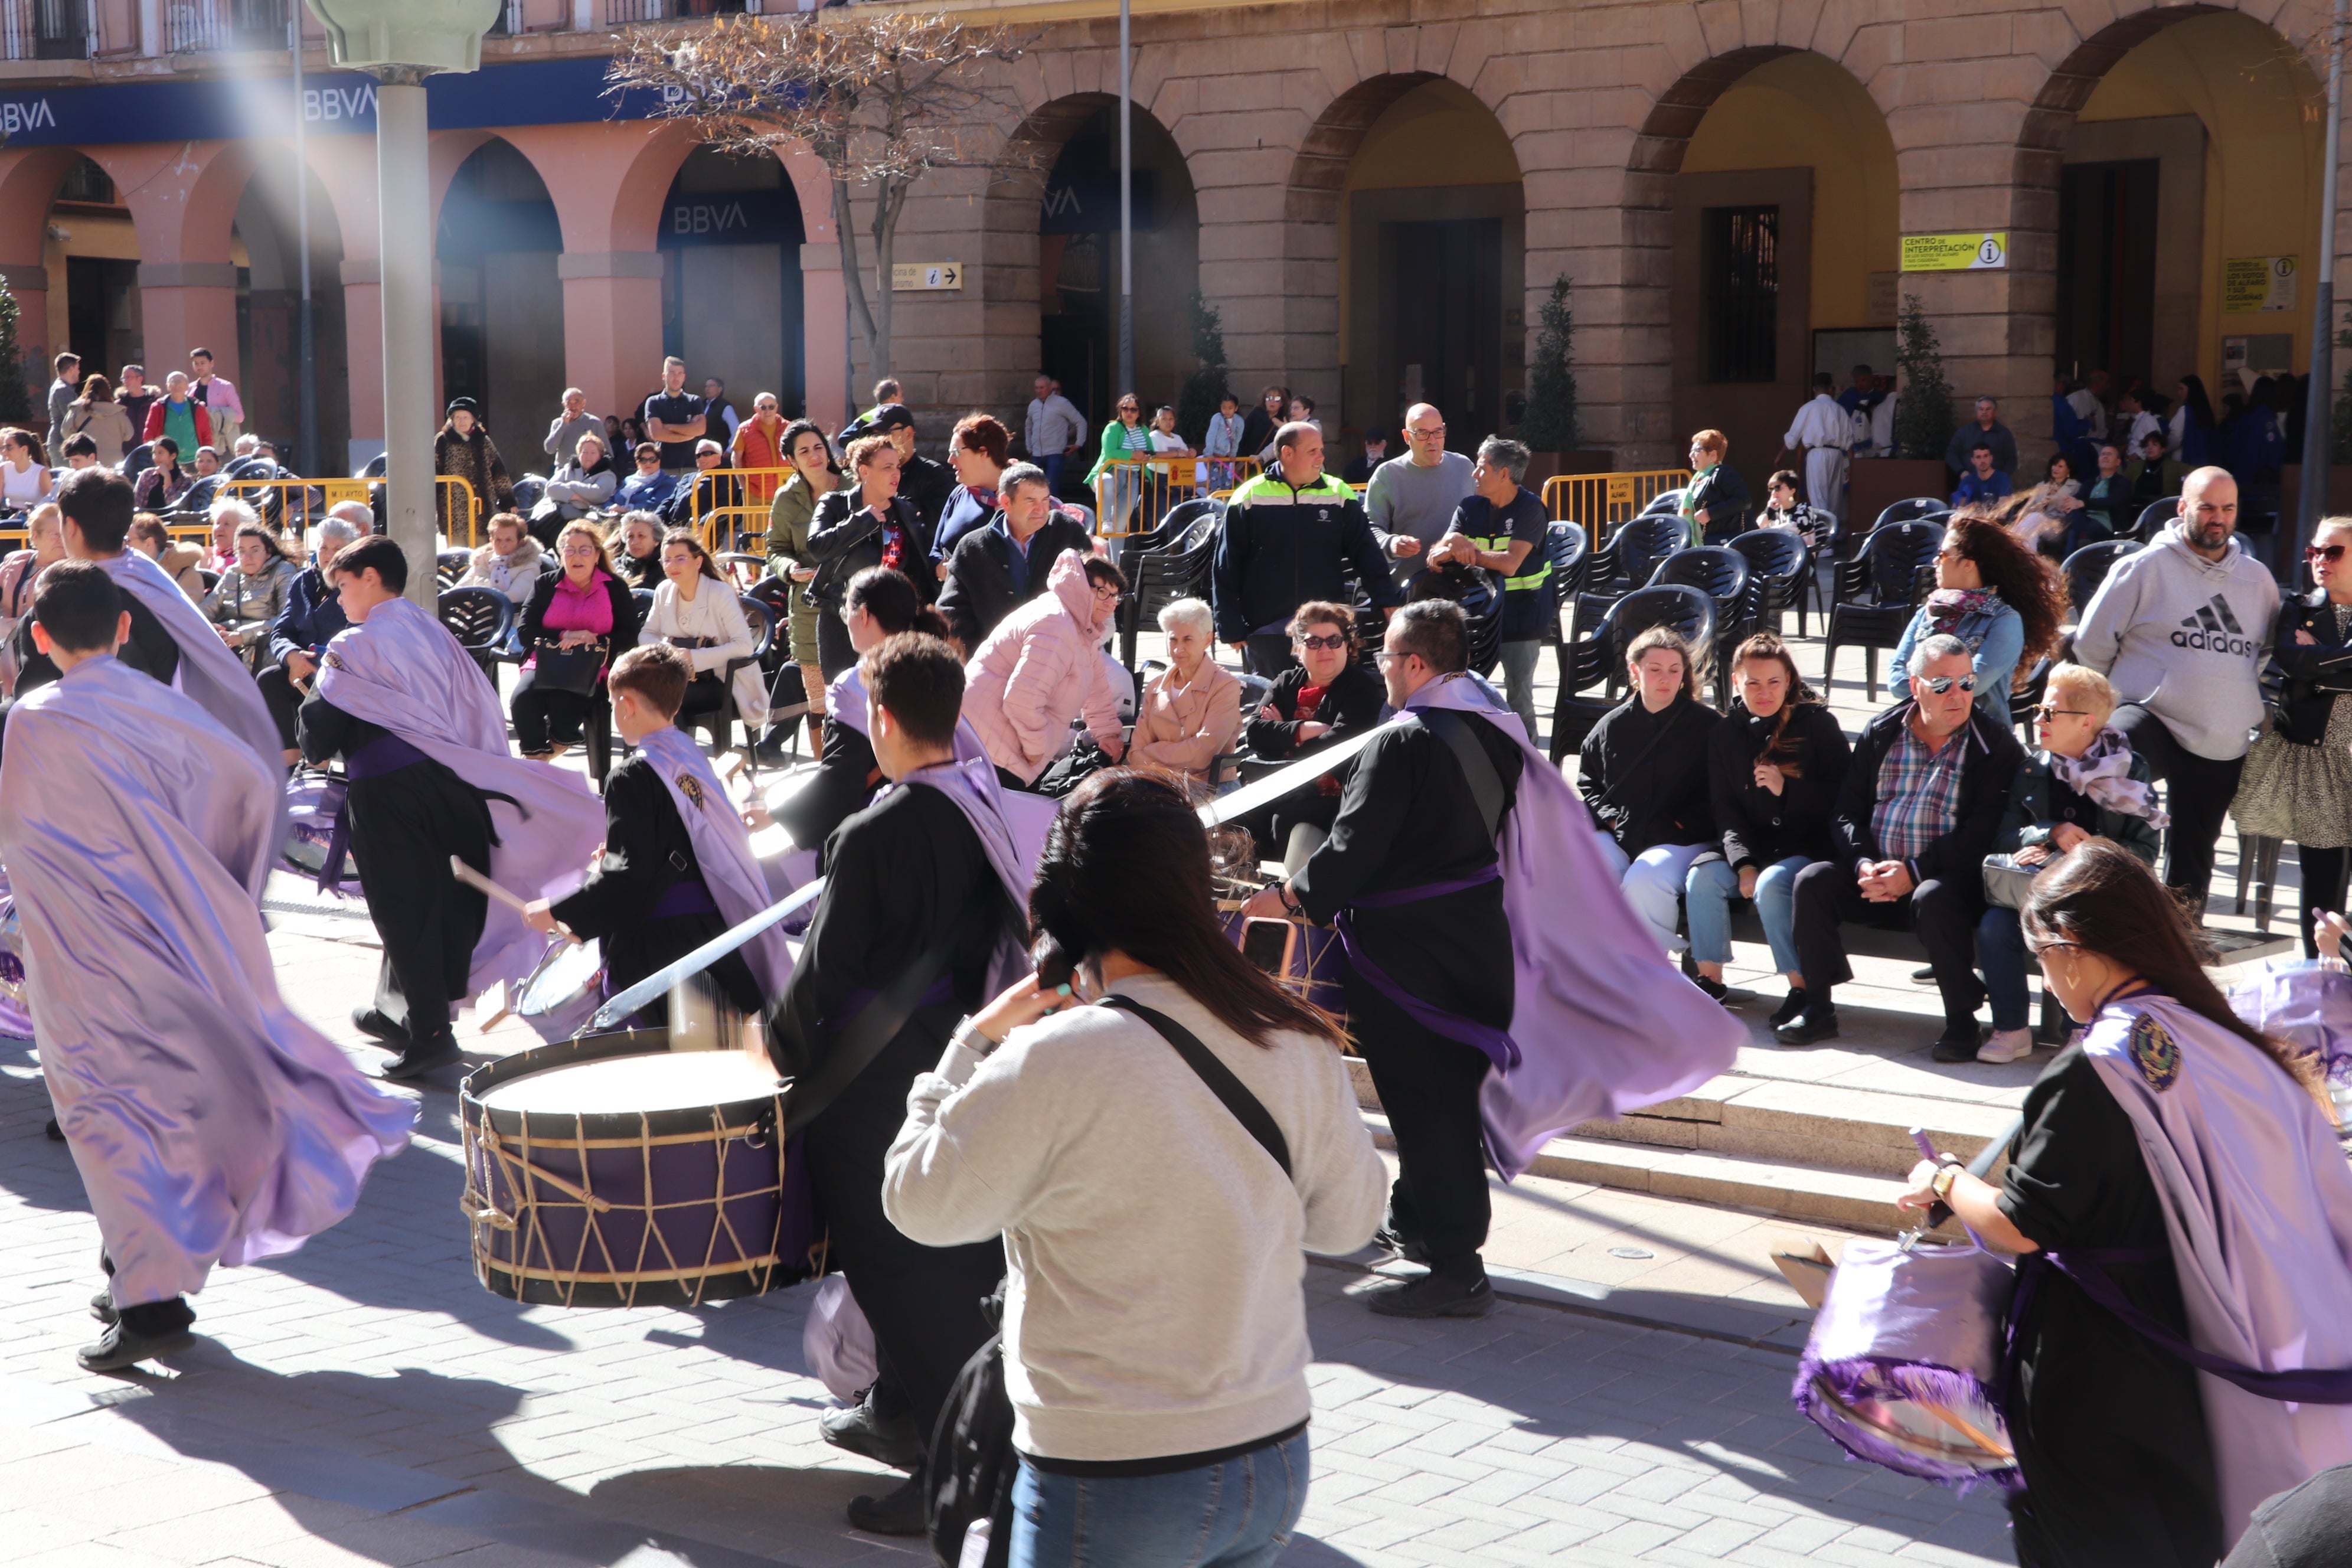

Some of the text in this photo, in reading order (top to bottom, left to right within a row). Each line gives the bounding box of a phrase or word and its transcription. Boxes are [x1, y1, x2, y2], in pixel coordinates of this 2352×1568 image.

[0, 98, 56, 133] BVA
[303, 83, 377, 121] BBVA
[674, 201, 747, 234] BBVA
[1042, 185, 1082, 219] VA
[1905, 237, 1936, 246] CENTRO
[1905, 241, 1975, 254] INTERPRETACIÓN
[892, 279, 914, 288] urismo
[2170, 629, 2252, 658] adidas
